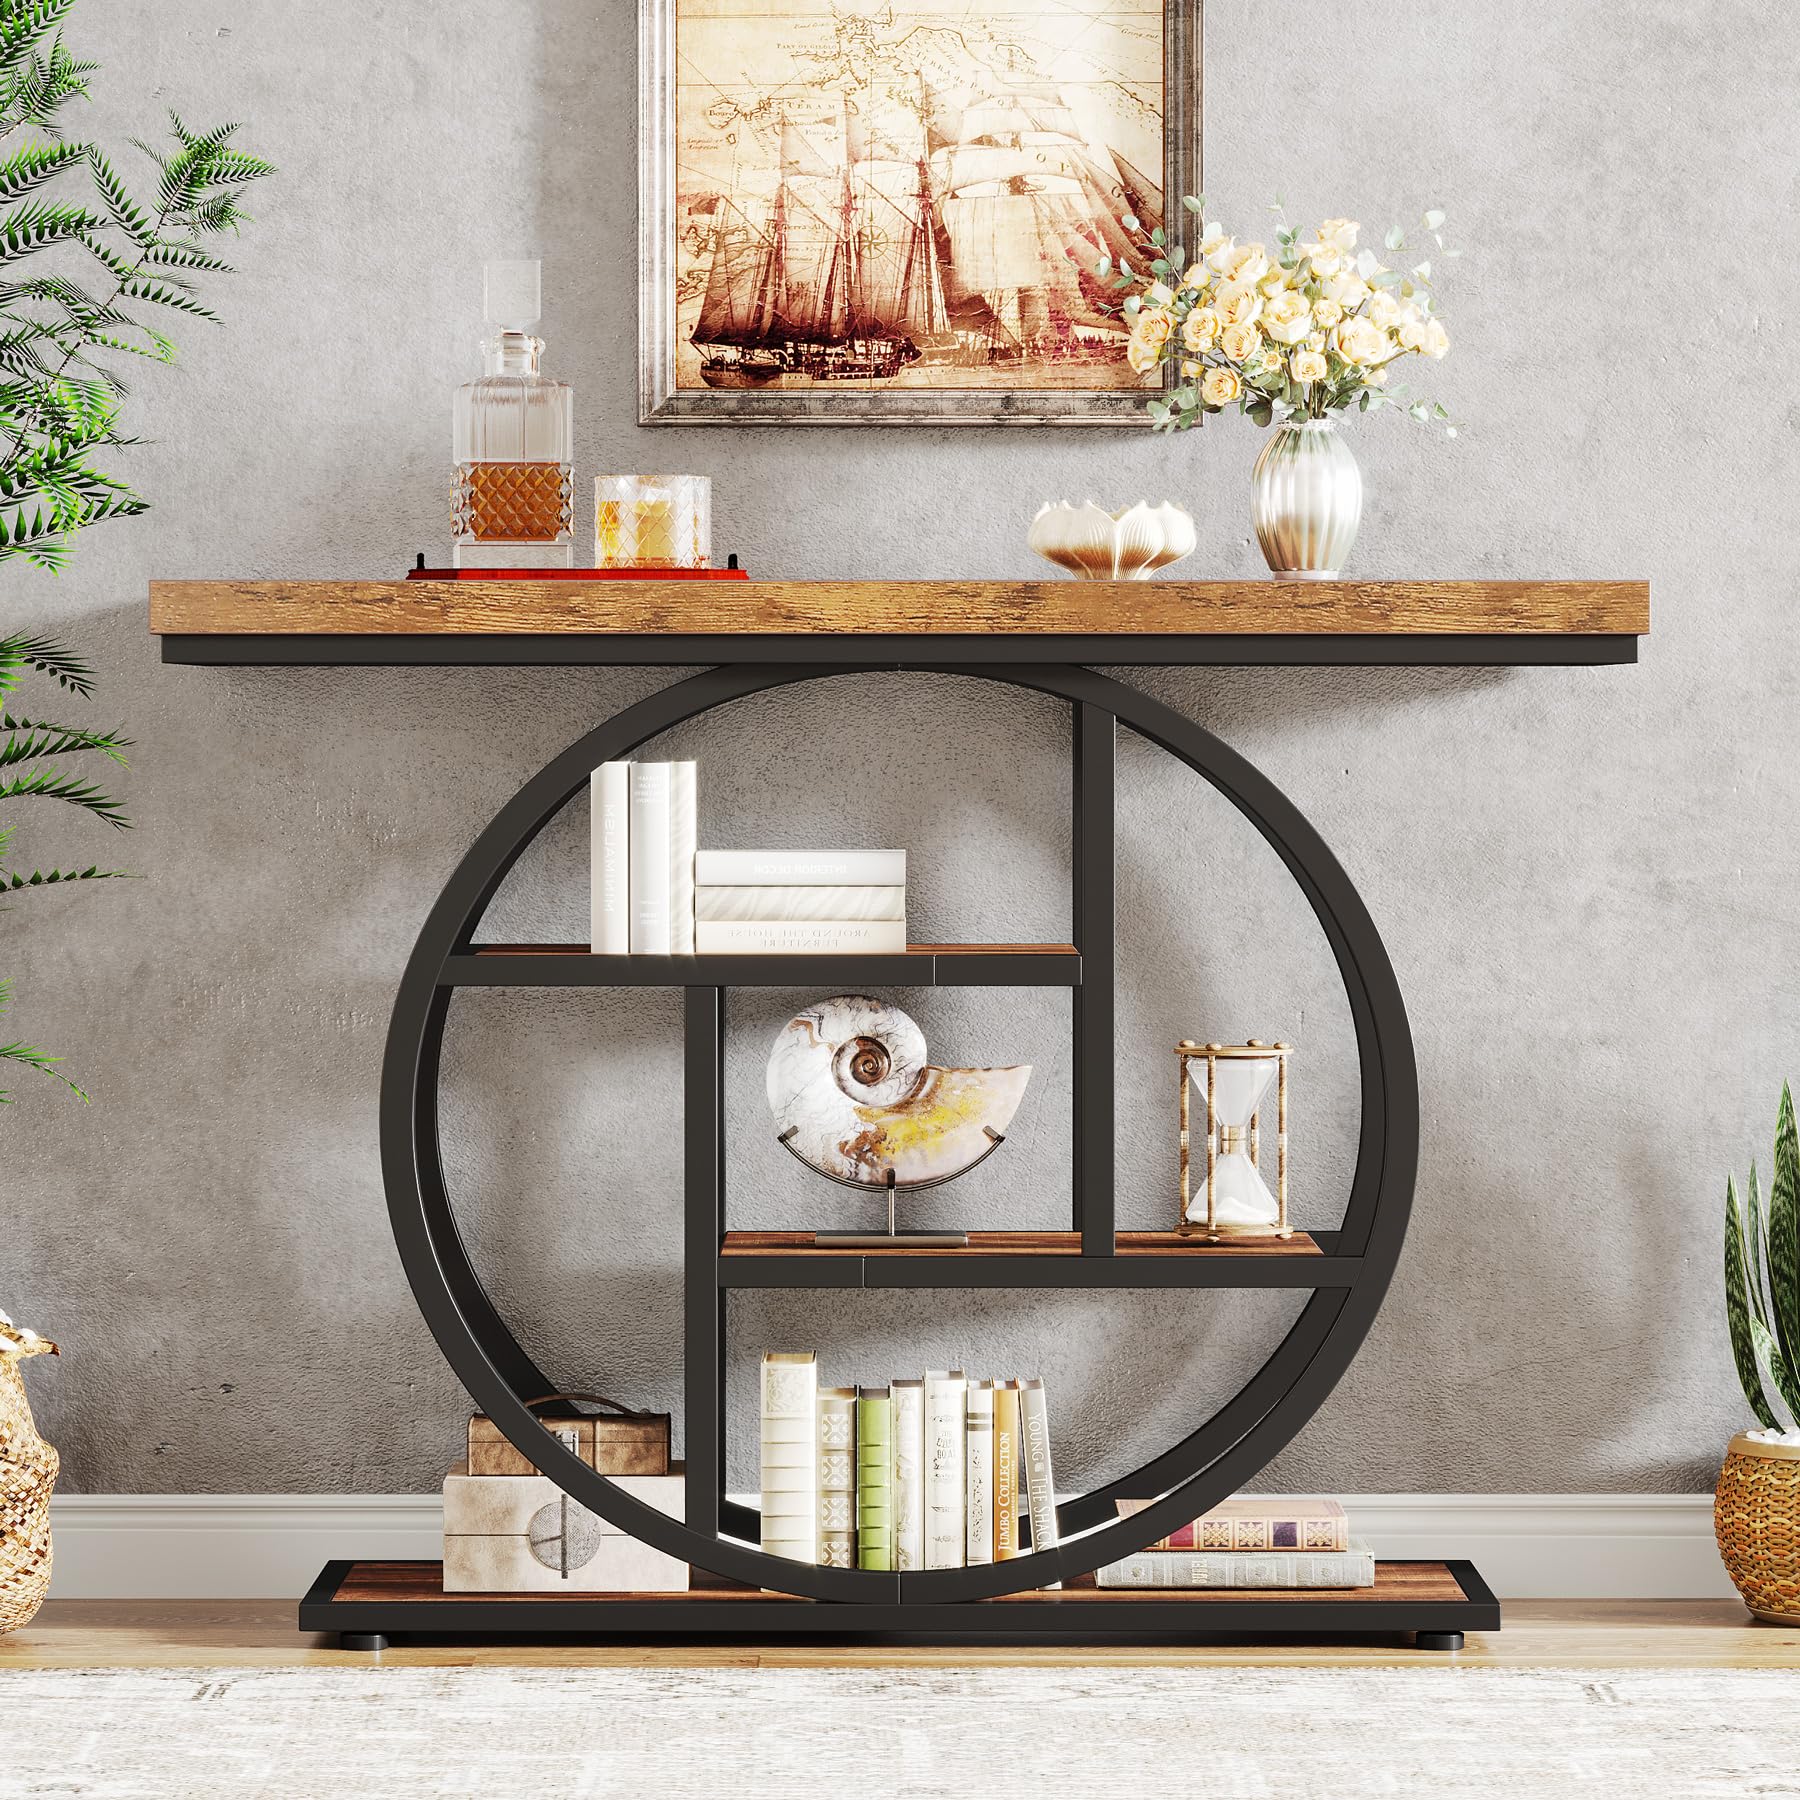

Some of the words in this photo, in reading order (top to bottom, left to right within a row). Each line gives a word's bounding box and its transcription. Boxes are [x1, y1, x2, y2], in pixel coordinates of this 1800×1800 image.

[1028, 1412, 1045, 1461] YOUNG
[997, 1431, 1011, 1507] COLLECTION
[1031, 1474, 1049, 1504] THE
[997, 1510, 1012, 1551] JUMBO
[1033, 1505, 1053, 1551] SHACK
